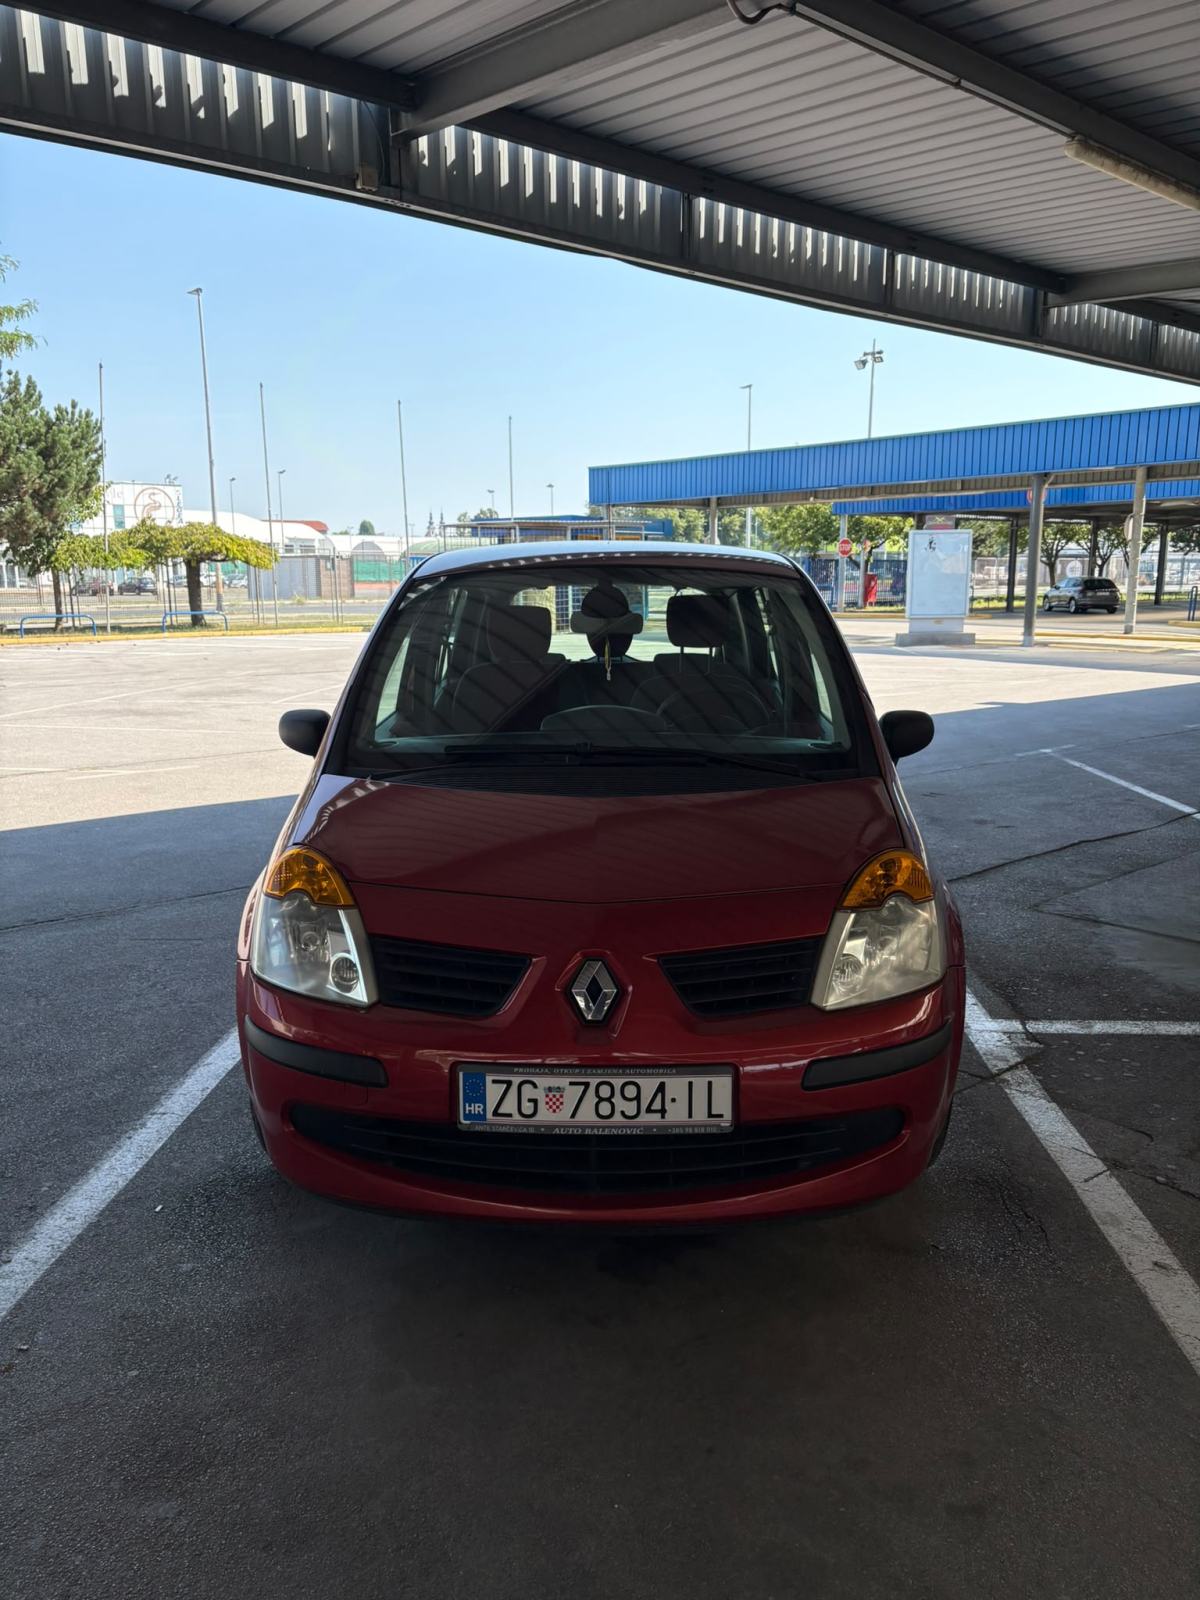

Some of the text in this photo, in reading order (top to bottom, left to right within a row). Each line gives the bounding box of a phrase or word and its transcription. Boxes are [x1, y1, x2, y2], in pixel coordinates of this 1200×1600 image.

[839, 543, 851, 551] STOP
[491, 1079, 539, 1119] ZG
[465, 1103, 484, 1114] HR
[553, 1127, 582, 1135] AUTO
